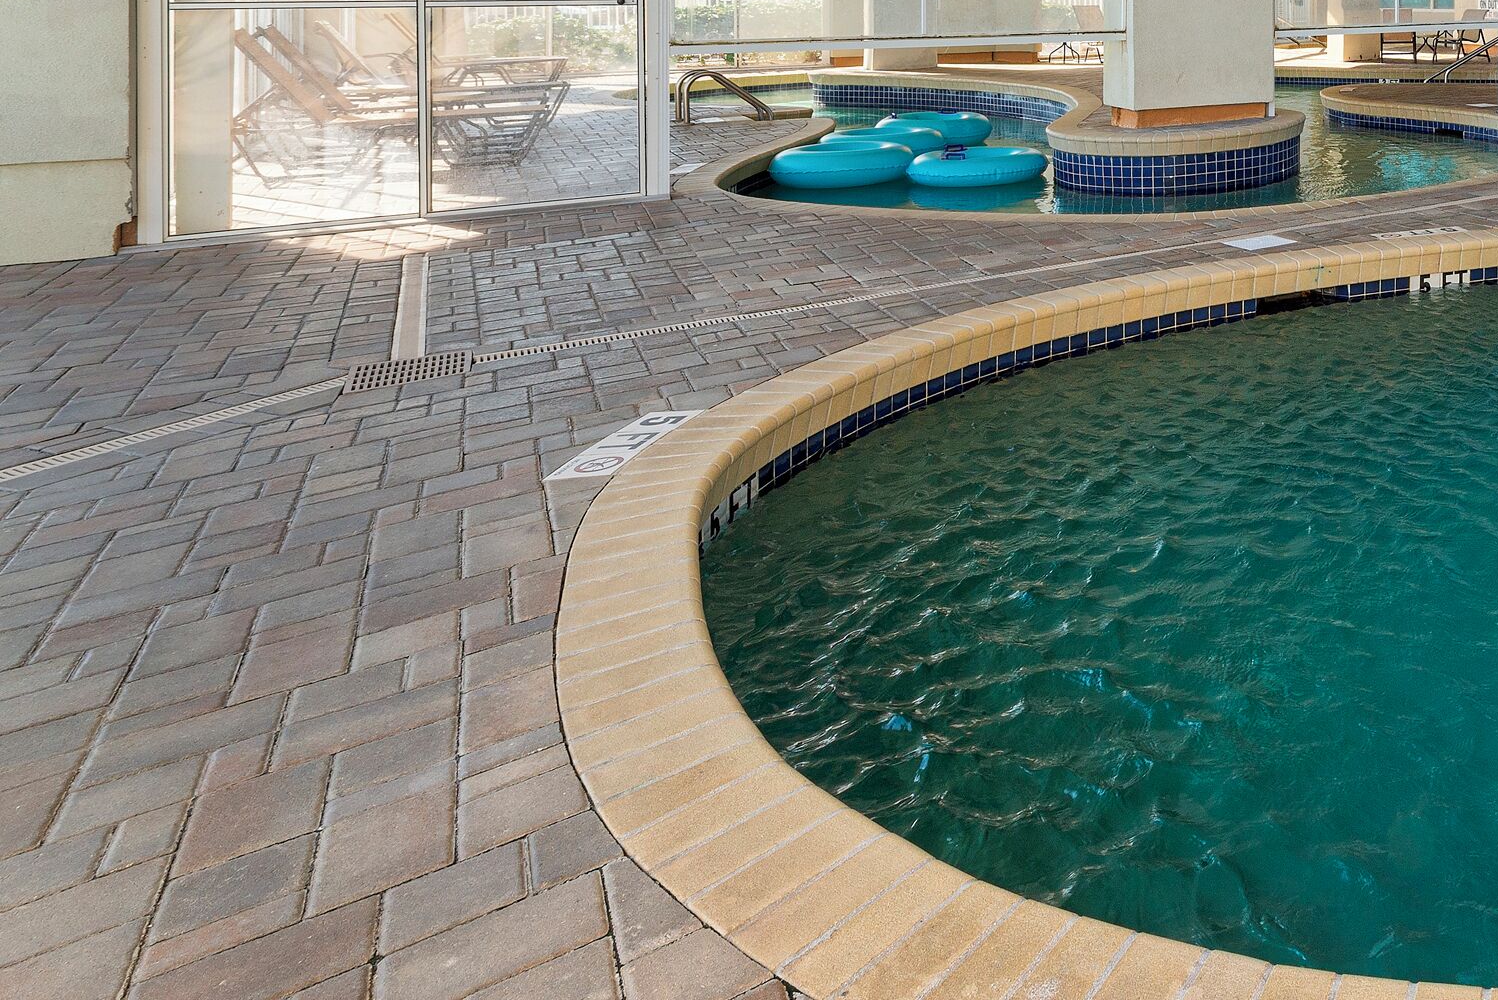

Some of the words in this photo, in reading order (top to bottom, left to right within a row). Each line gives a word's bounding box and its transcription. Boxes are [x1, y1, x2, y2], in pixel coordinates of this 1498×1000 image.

[1420, 274, 1431, 293] 5
[1443, 270, 1468, 289] FT
[640, 415, 688, 426] 5
[598, 432, 661, 450] FT
